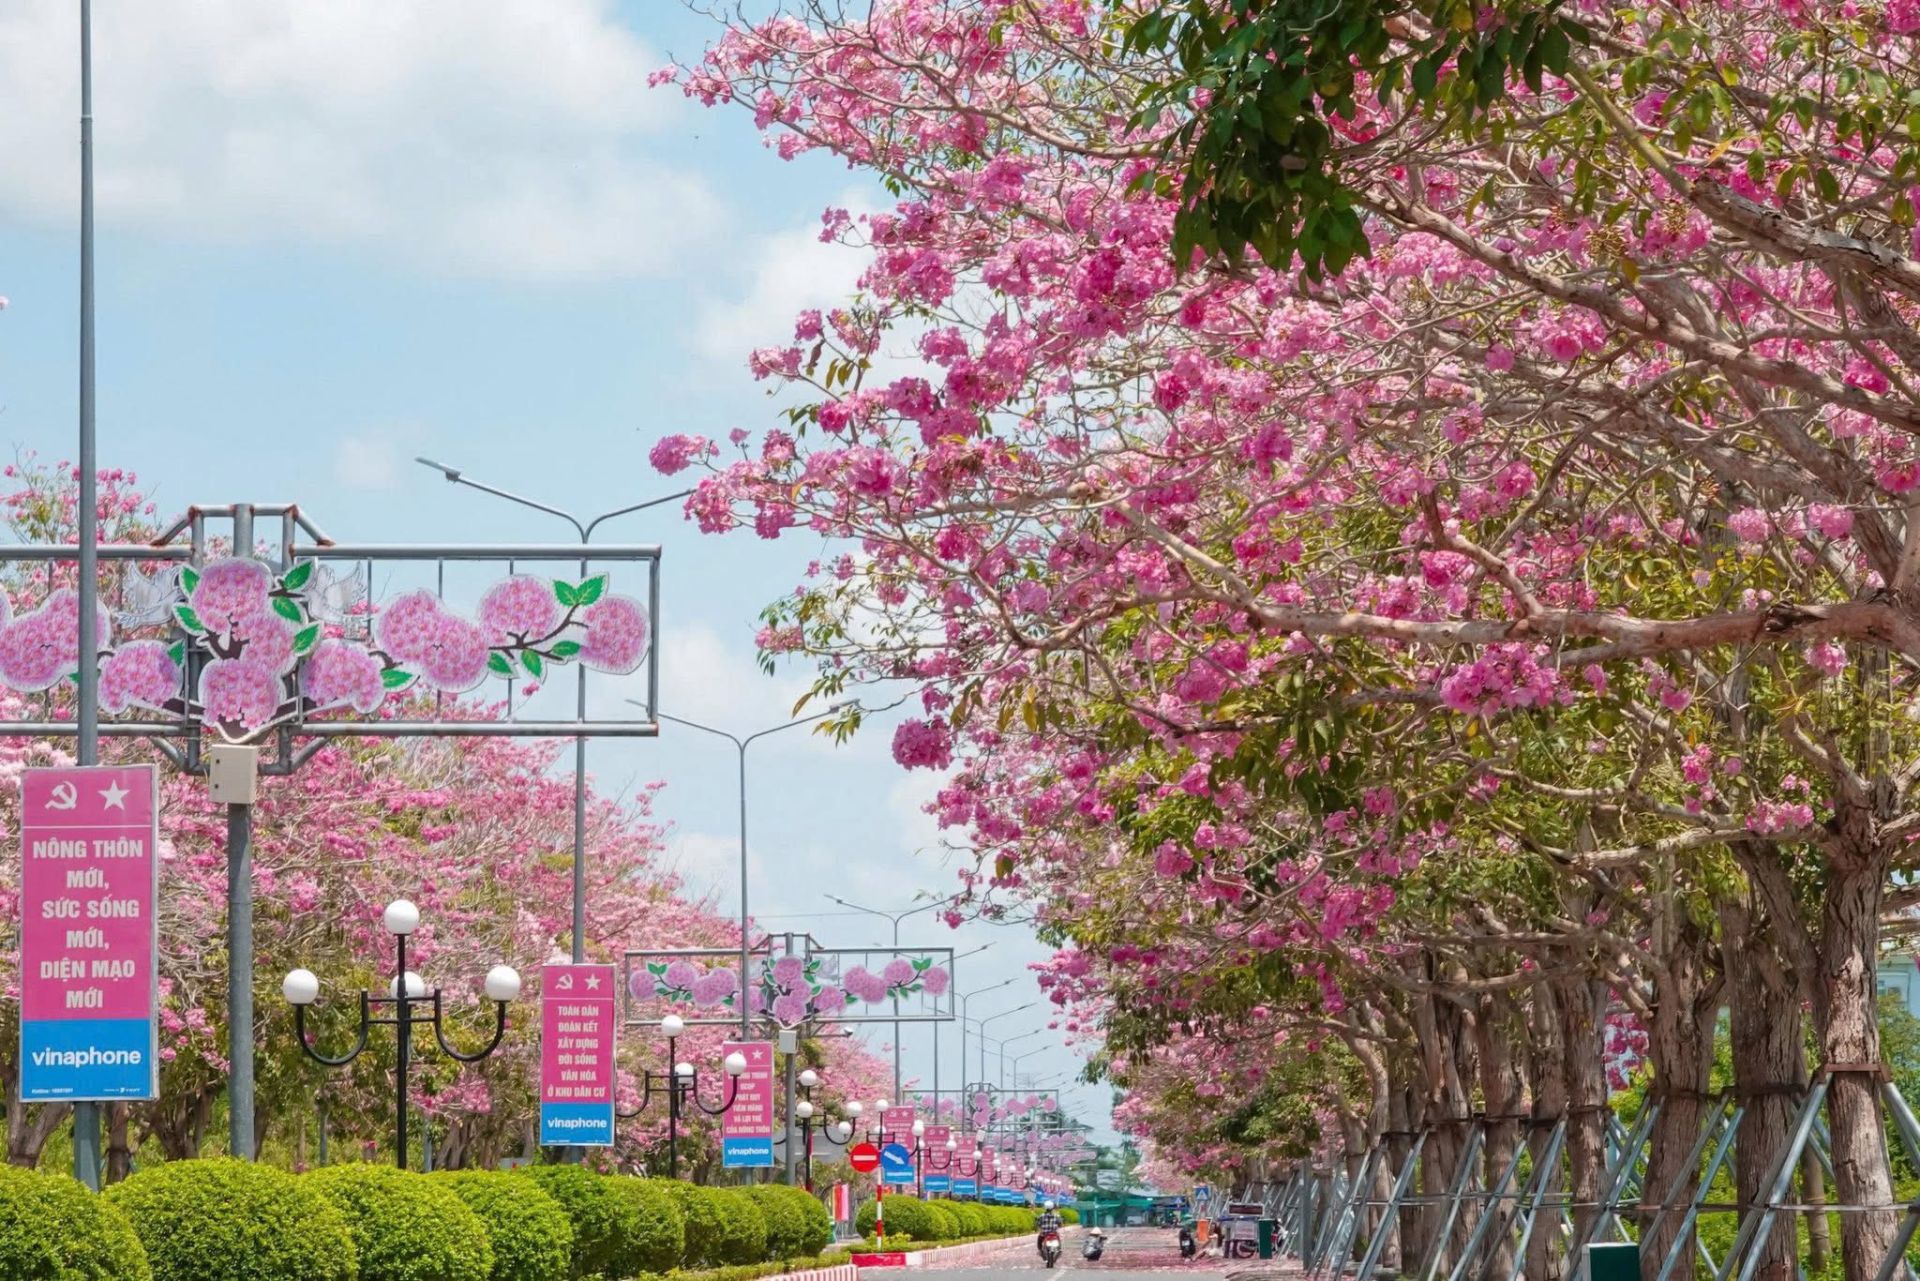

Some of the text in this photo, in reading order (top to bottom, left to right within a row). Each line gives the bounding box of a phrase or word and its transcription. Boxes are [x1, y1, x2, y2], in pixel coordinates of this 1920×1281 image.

[33, 836, 143, 858] NÔNG THÔN
[67, 867, 109, 890] MỚI,
[42, 894, 140, 918] SỨC SỐNG
[66, 926, 109, 950] MỚI,
[40, 957, 136, 982] DIỆN MẠO
[66, 986, 104, 1009] MỚI
[558, 1004, 599, 1017] TOÀN DÂN
[558, 1020, 598, 1033] ĐOÀN KẾT
[557, 1036, 599, 1051] XÂY DỰNG
[32, 1046, 141, 1068] vinaphone
[558, 1051, 598, 1065] ĐỜI SỐNG
[561, 1069, 597, 1081] VĂN HÓA
[547, 1084, 606, 1097] Ở KHU DÂN CƯ
[547, 1117, 608, 1130] vinaphone
[727, 1147, 769, 1156] vinaphone
